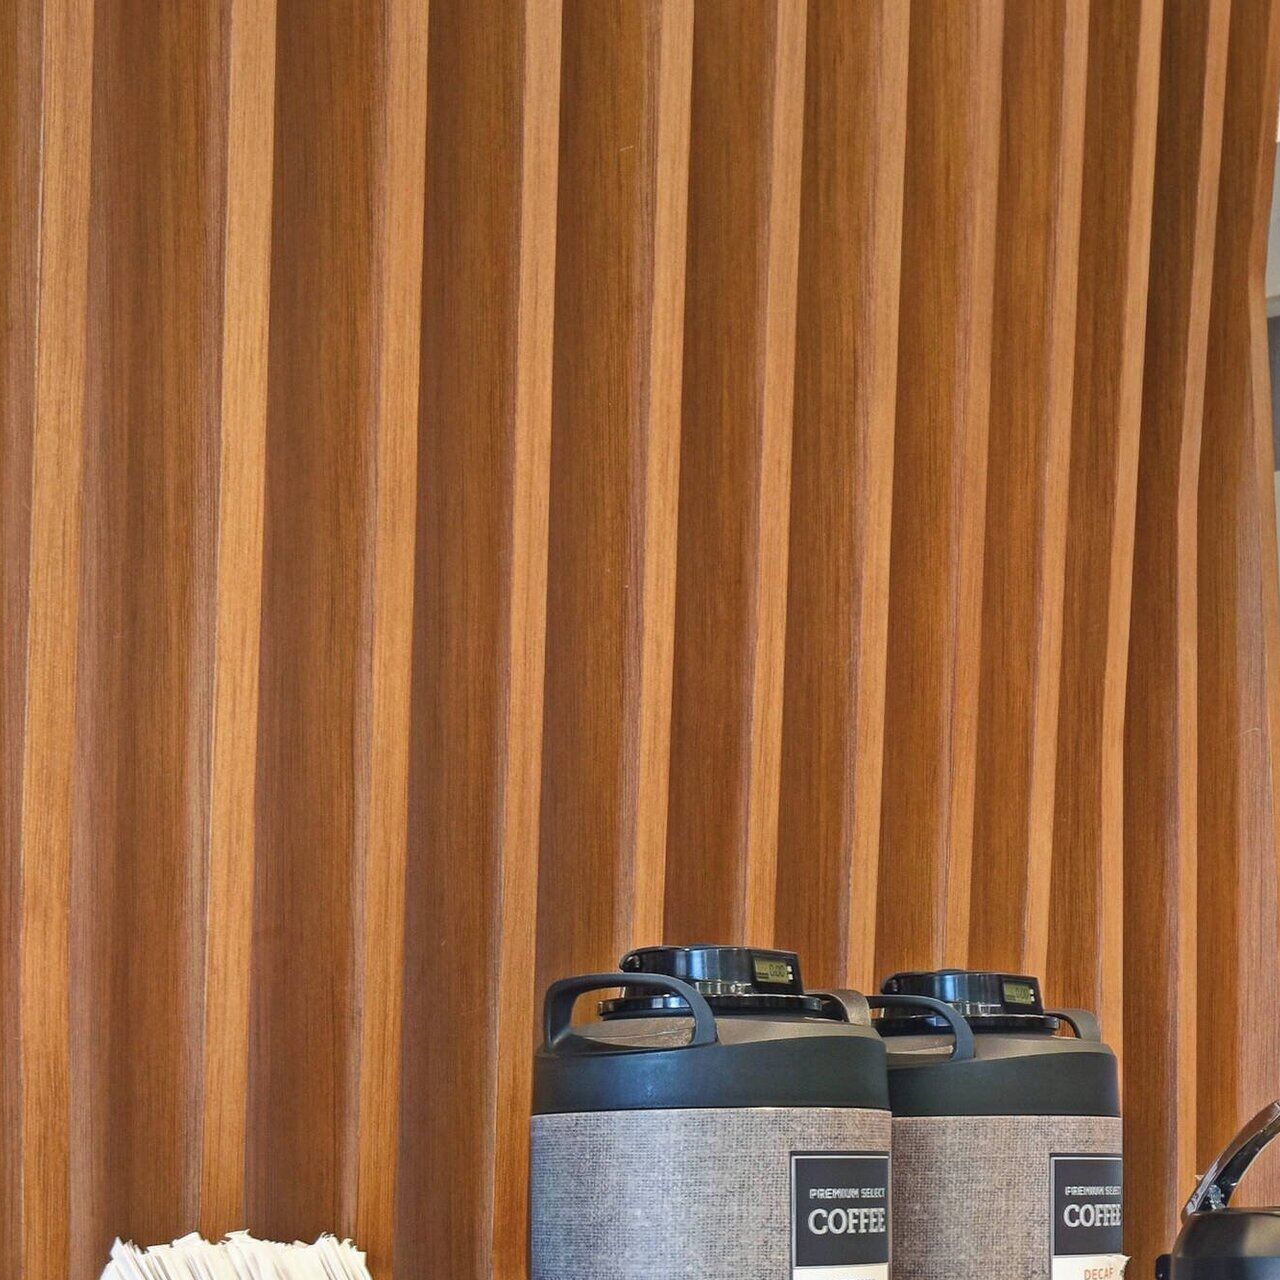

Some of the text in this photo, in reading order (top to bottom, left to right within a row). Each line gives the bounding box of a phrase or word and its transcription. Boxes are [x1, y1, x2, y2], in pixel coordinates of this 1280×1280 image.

[809, 1187, 885, 1199] PREMIUM SELECT
[1065, 1186, 1104, 1196] PREMIUM
[808, 1207, 886, 1235] COFFEE
[1084, 1266, 1114, 1280] DECAF
